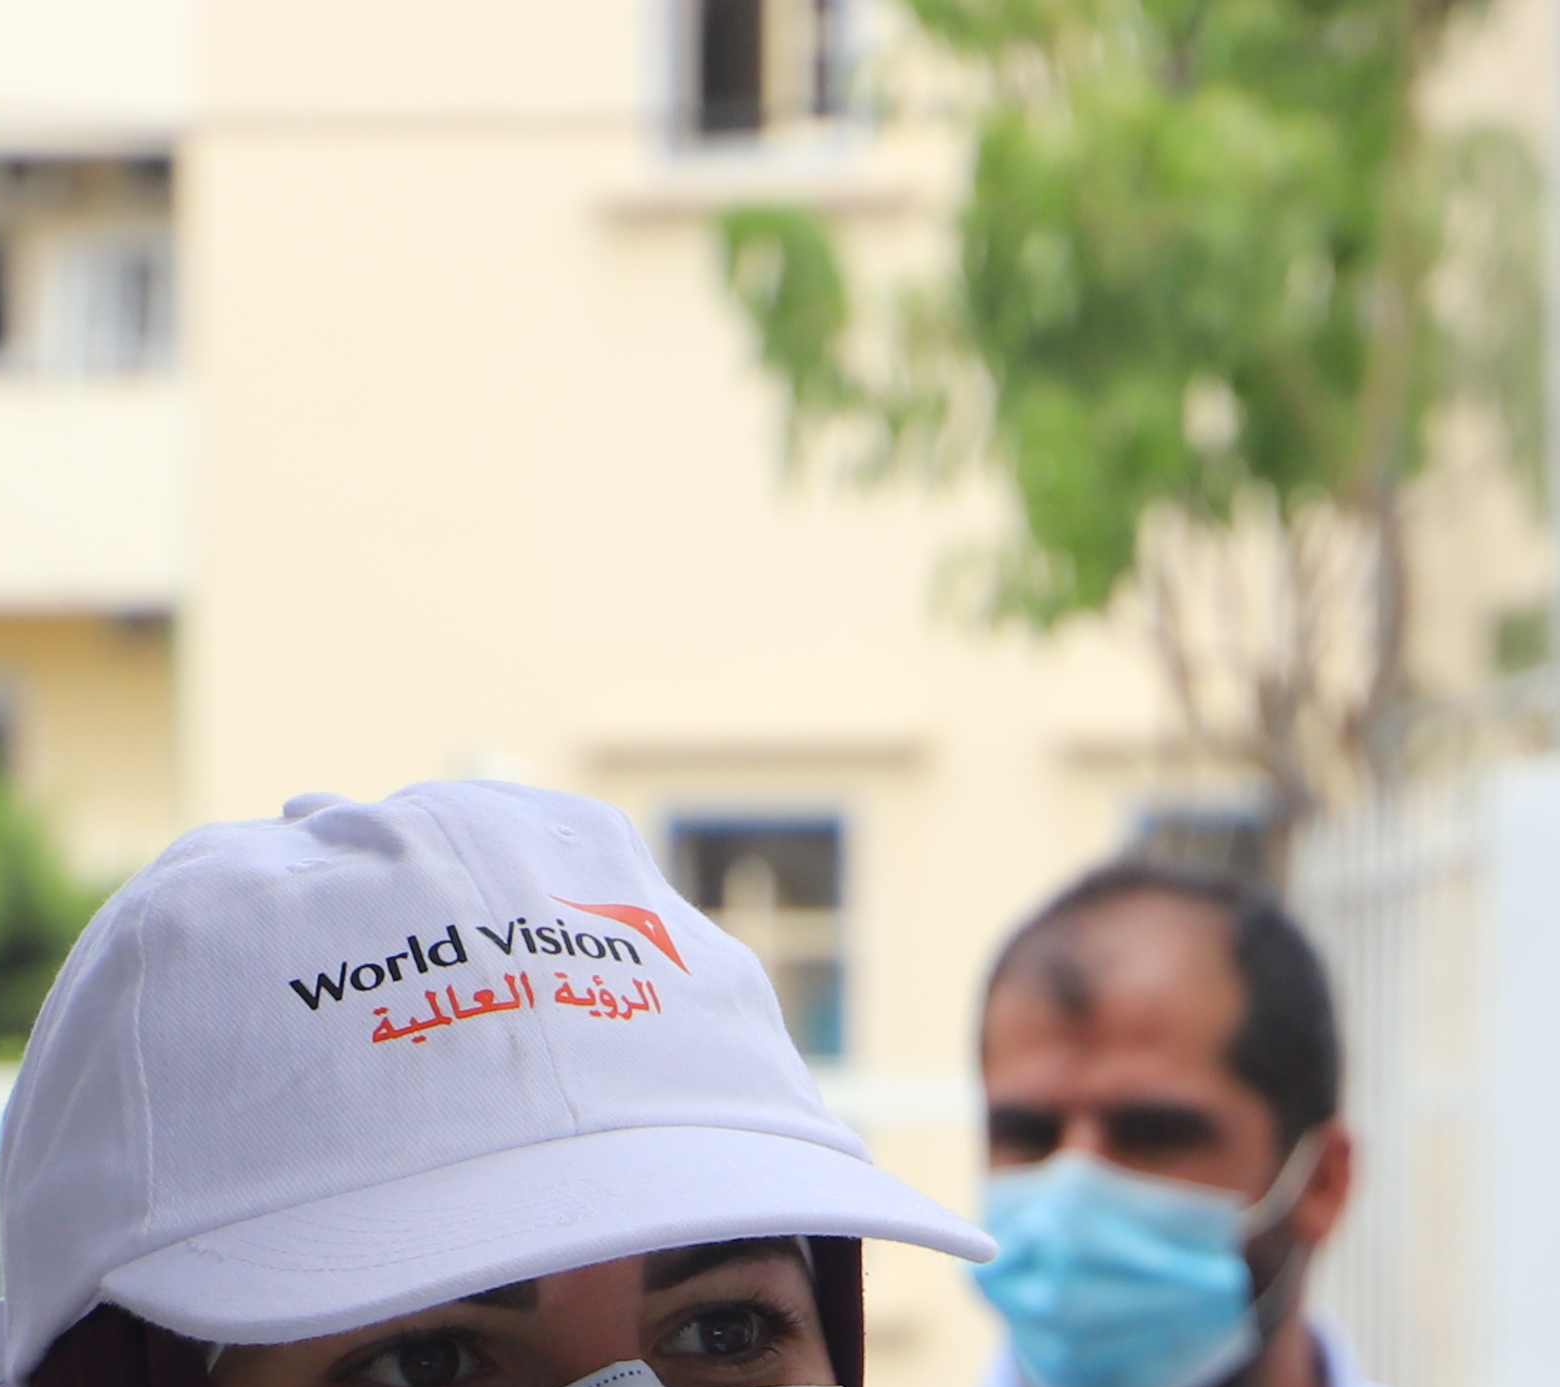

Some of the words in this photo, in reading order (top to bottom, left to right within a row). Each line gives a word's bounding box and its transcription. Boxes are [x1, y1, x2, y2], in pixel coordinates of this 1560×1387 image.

[289, 924, 470, 1011] World
[476, 917, 642, 965] Vision
[555, 972, 662, 1021] الرؤية
[372, 970, 536, 1044] العالمية
